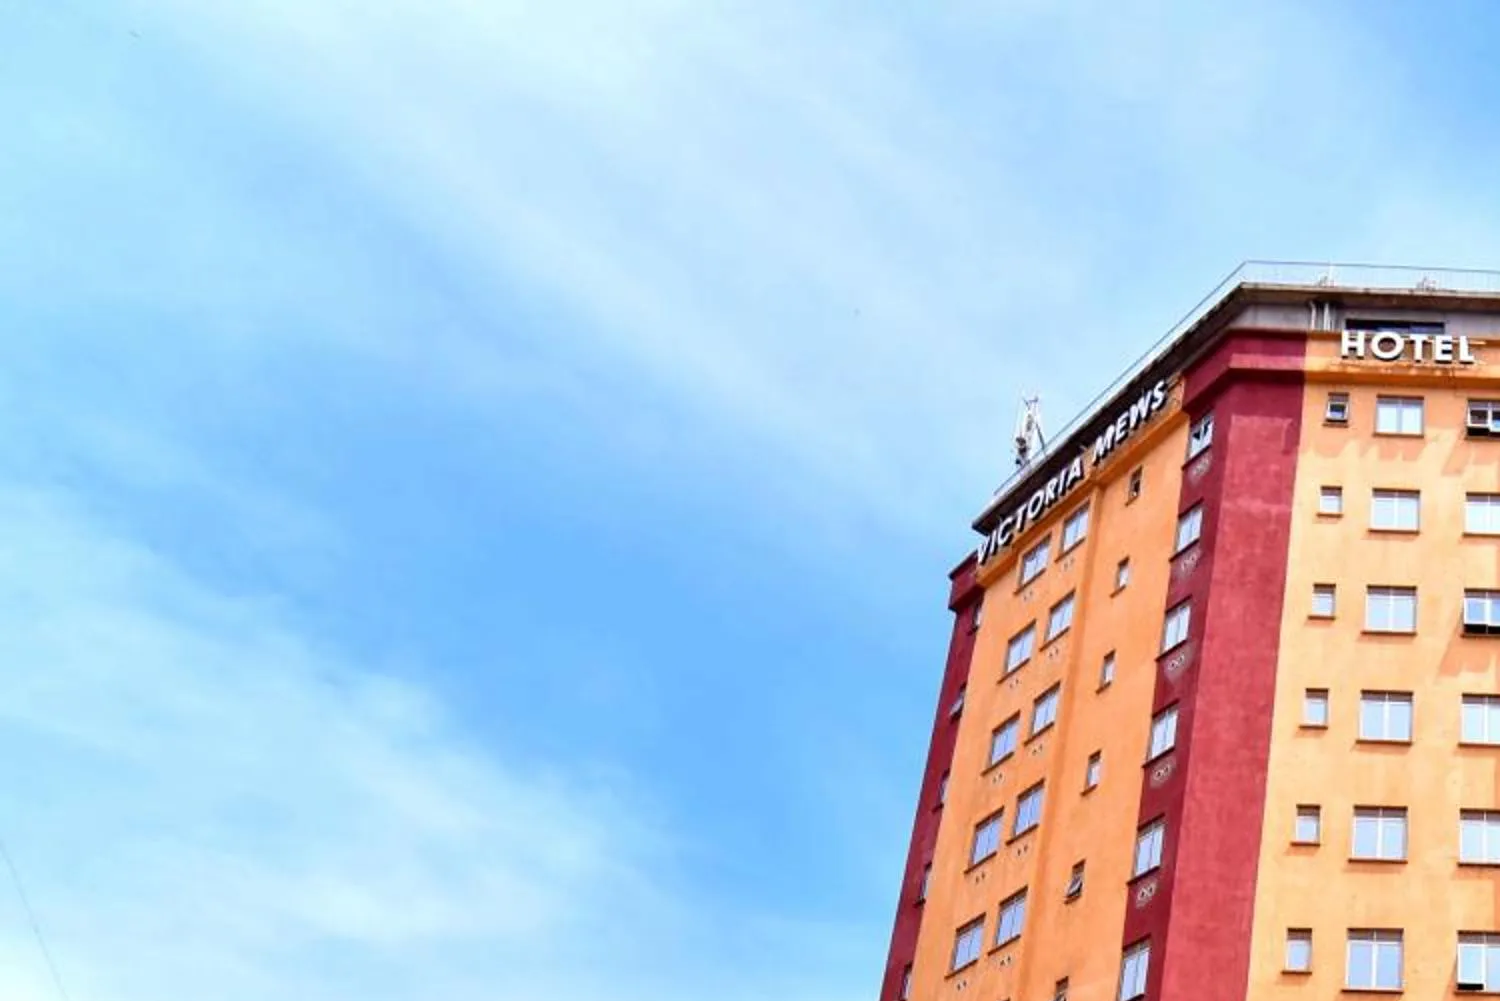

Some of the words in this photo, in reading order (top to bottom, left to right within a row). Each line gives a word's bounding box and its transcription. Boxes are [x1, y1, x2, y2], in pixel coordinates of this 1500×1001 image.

[1341, 329, 1475, 364] HOTEL
[977, 457, 1084, 566] VICTORIA
[1092, 380, 1168, 465] MEWS
